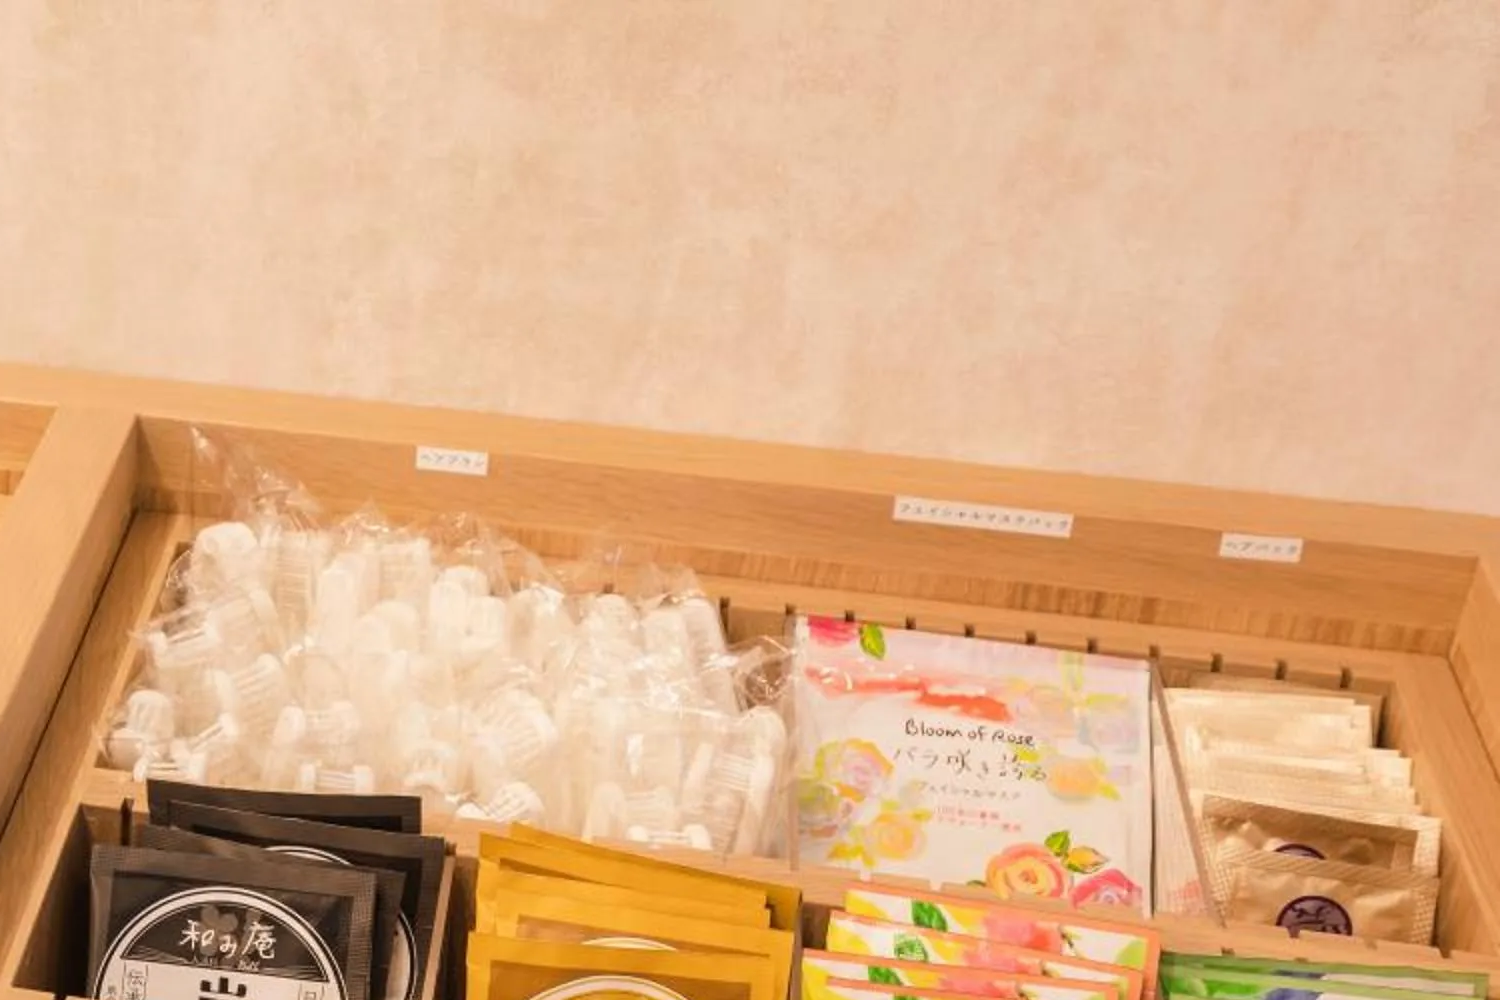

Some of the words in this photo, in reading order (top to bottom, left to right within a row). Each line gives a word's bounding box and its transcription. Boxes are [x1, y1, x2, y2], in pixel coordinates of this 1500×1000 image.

[904, 717, 963, 738] Bloom
[967, 725, 987, 742] of
[991, 729, 1036, 747] Rose
[180, 918, 277, 960] 和み庵
